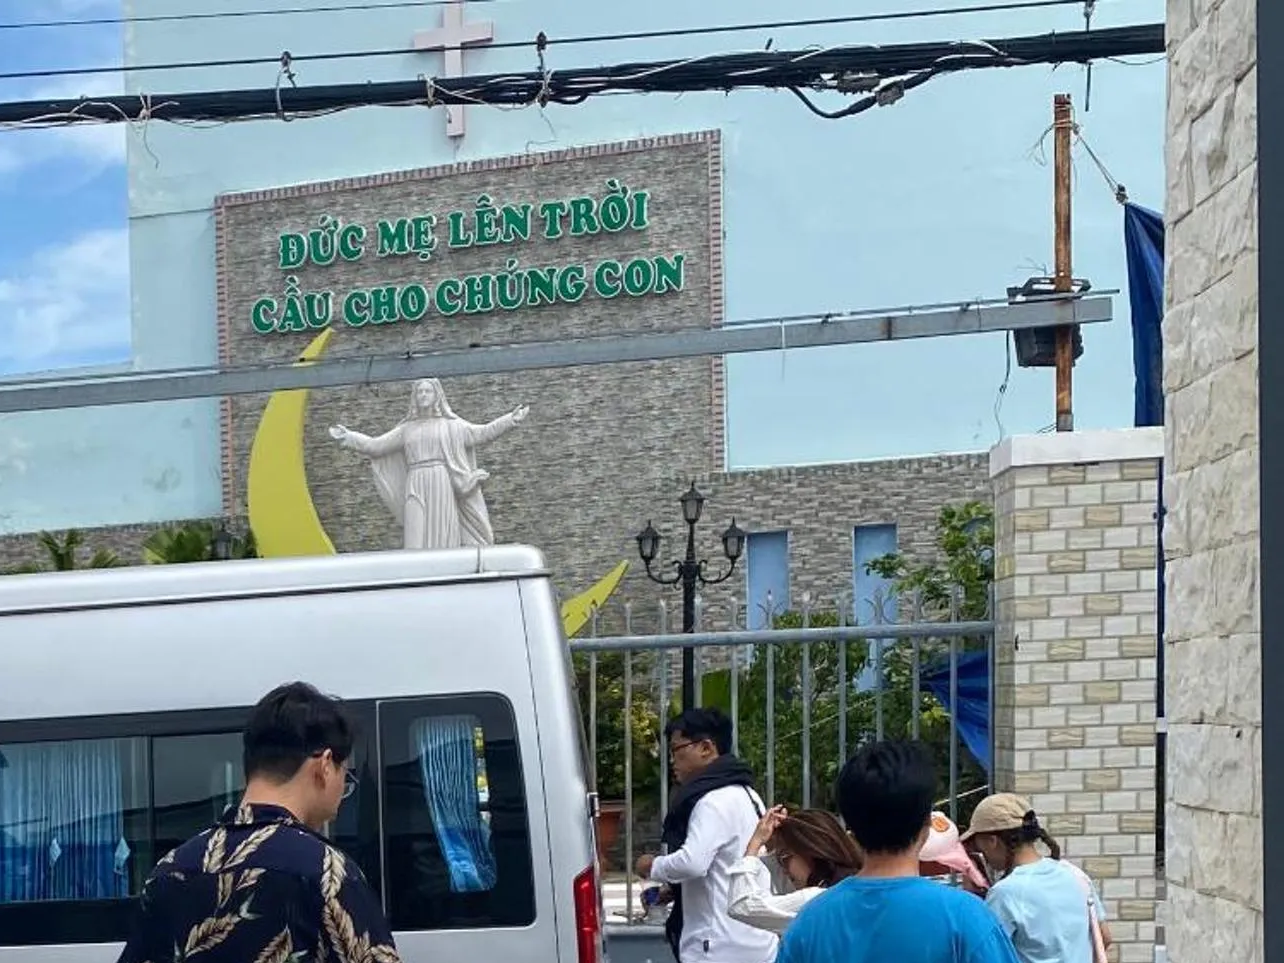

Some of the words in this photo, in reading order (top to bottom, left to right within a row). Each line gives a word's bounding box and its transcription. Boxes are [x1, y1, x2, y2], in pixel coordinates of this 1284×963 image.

[278, 216, 365, 269] ĐỨC
[376, 214, 438, 262] MẸ
[447, 194, 531, 247] LÊN
[539, 179, 651, 237] TRỜI
[250, 275, 333, 334] CẦU
[343, 283, 429, 328] CHO
[434, 259, 585, 316] CHÚNG
[594, 254, 686, 298] CON
